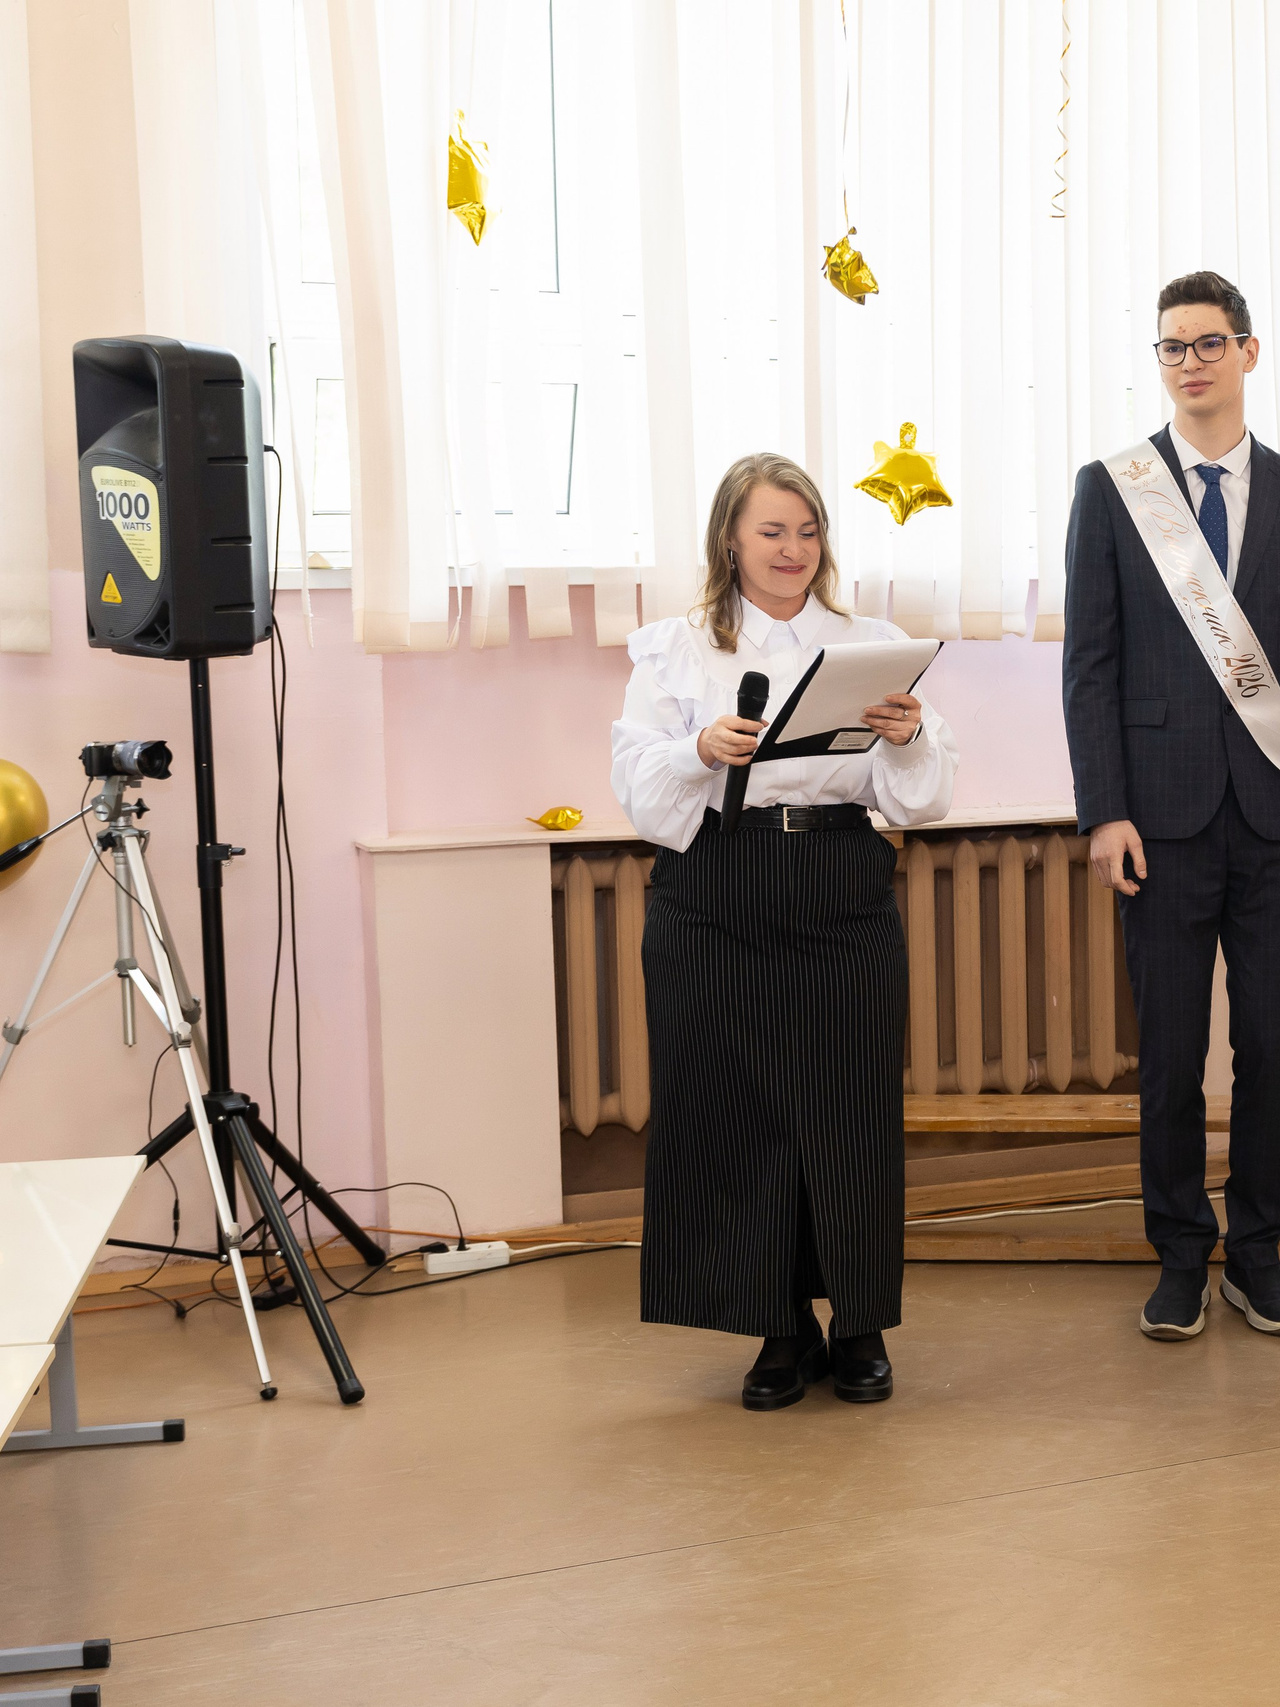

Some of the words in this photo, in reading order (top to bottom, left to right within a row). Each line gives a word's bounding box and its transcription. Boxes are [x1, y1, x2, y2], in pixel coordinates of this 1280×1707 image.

[98, 491, 150, 520] 1000
[122, 521, 152, 531] WATTS
[1139, 490, 1237, 650] Выпускник
[1222, 652, 1271, 699] 2026
